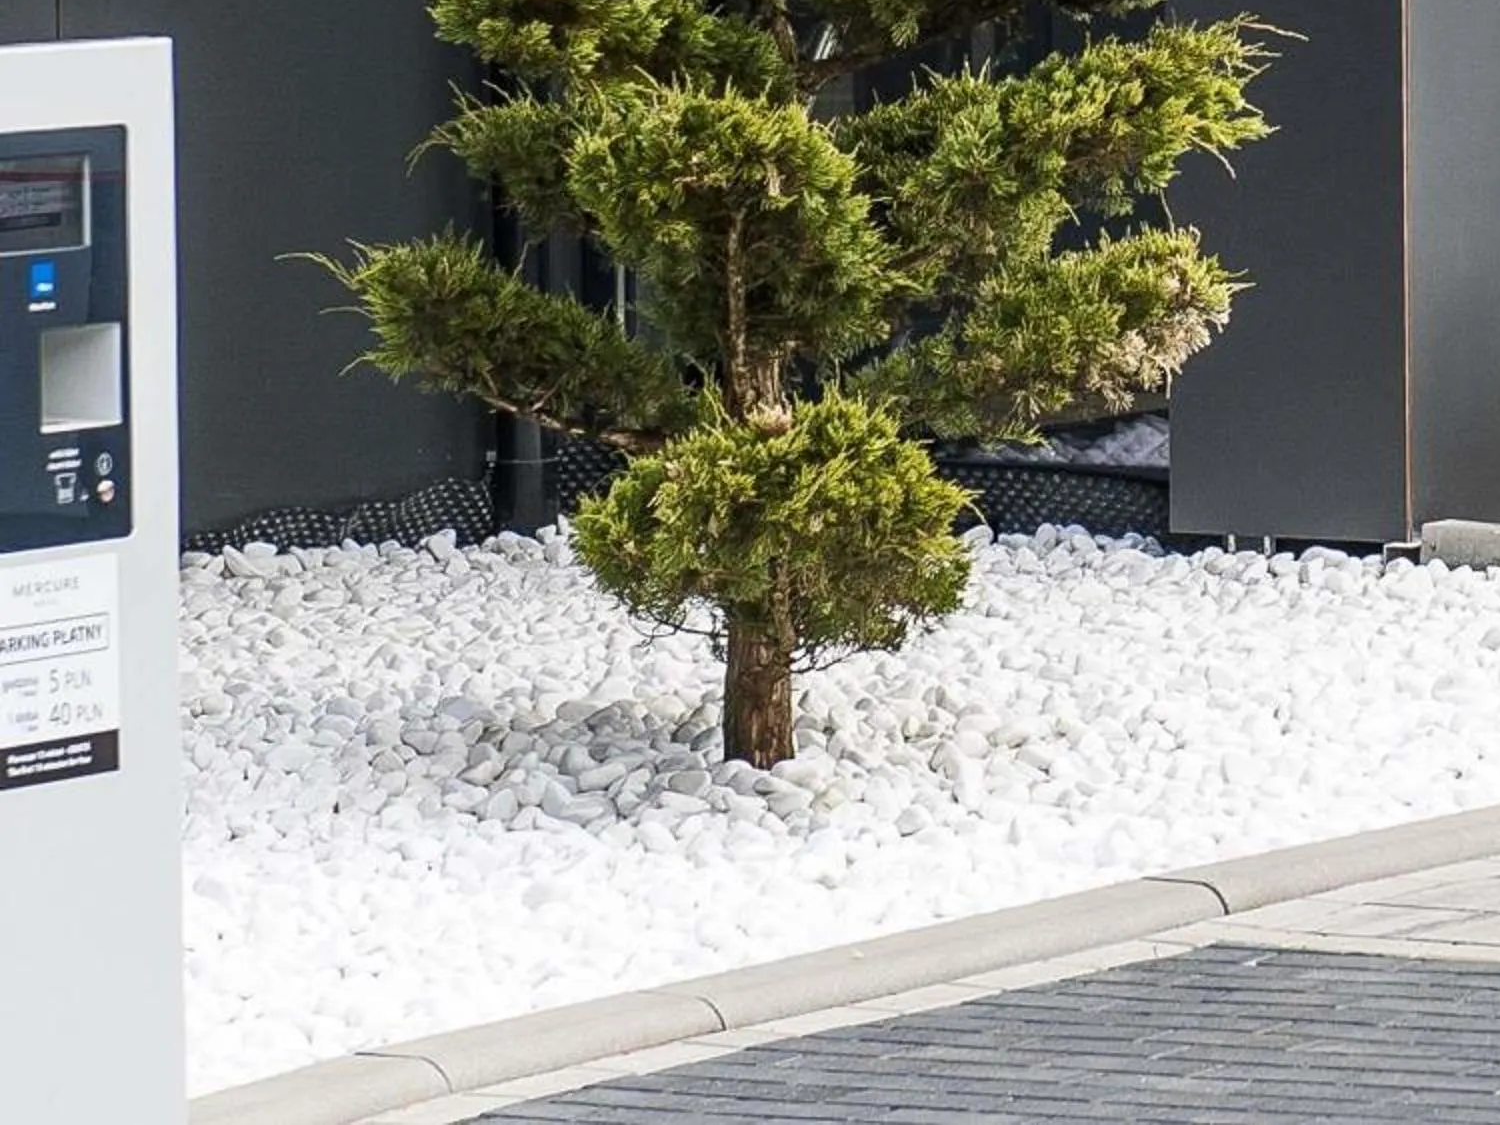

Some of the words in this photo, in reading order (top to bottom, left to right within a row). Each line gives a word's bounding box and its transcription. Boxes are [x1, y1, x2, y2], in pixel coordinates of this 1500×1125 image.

[49, 668, 60, 694] 5
[64, 670, 92, 689] PLN
[48, 702, 71, 726] 40
[77, 703, 103, 723] PLN
